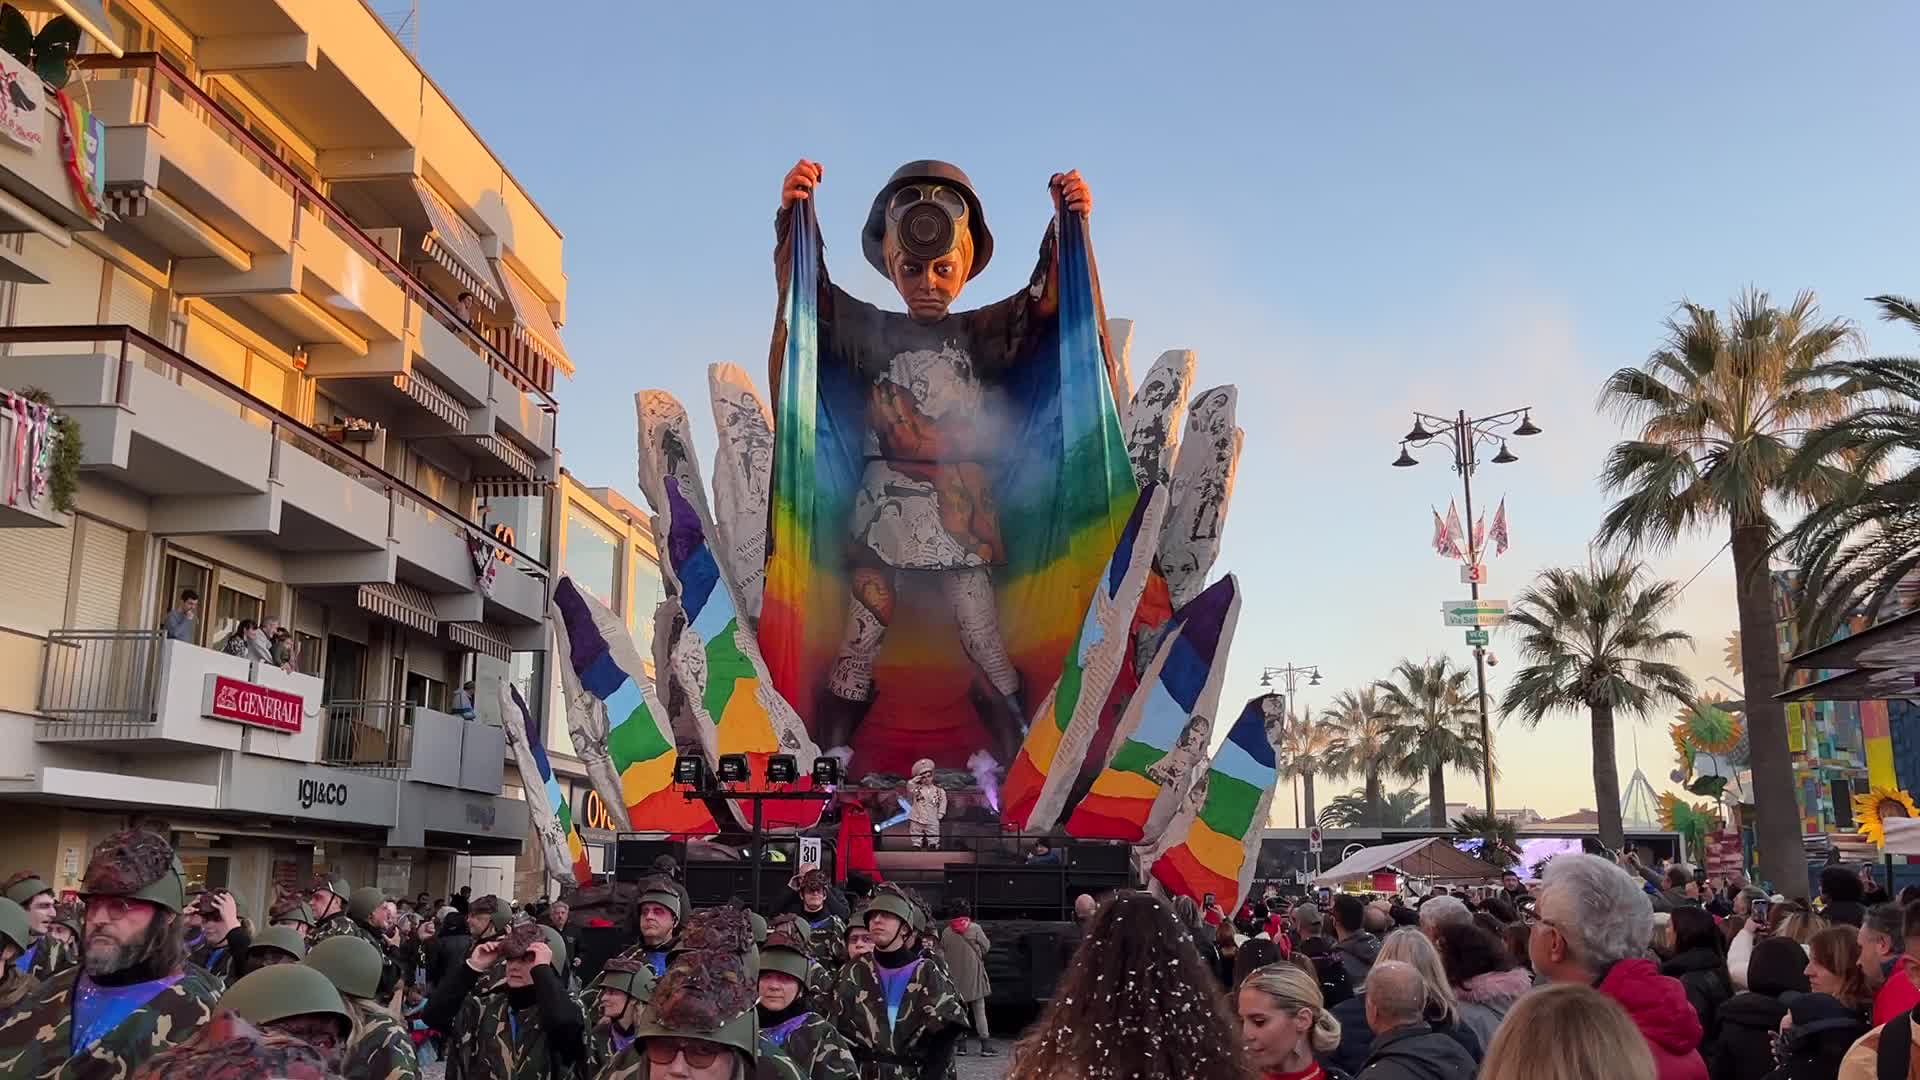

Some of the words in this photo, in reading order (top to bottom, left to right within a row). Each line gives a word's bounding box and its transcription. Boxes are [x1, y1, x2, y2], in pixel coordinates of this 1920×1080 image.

[1469, 567, 1479, 580] 3
[238, 690, 300, 724] GENERALI
[803, 846, 817, 862] 30
